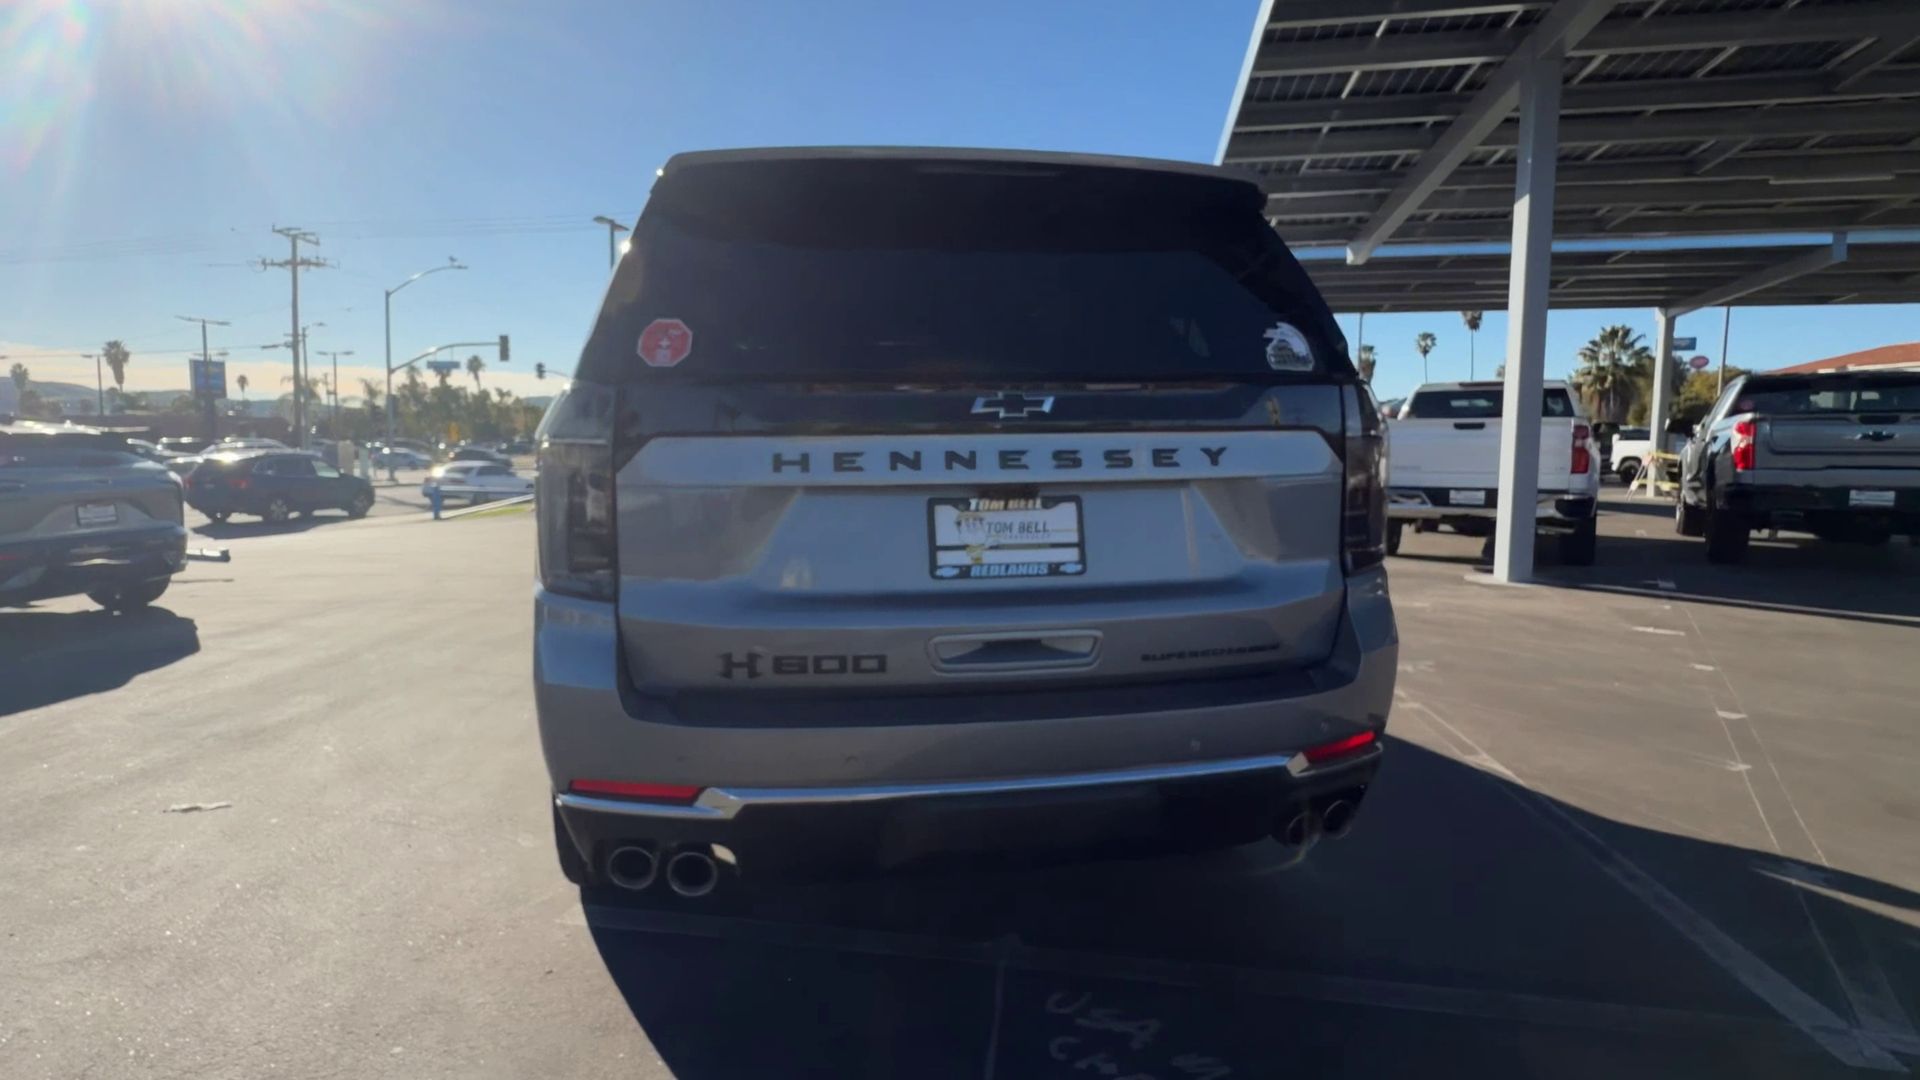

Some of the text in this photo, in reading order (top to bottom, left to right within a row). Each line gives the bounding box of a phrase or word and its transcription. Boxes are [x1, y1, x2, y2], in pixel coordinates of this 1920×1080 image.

[770, 446, 1227, 474] HENNESSEY
[969, 498, 1005, 511] TOM
[986, 520, 1050, 533] TOM BELL
[970, 563, 1048, 577] REDLANDS
[1140, 642, 1280, 662] SUPERCHA
